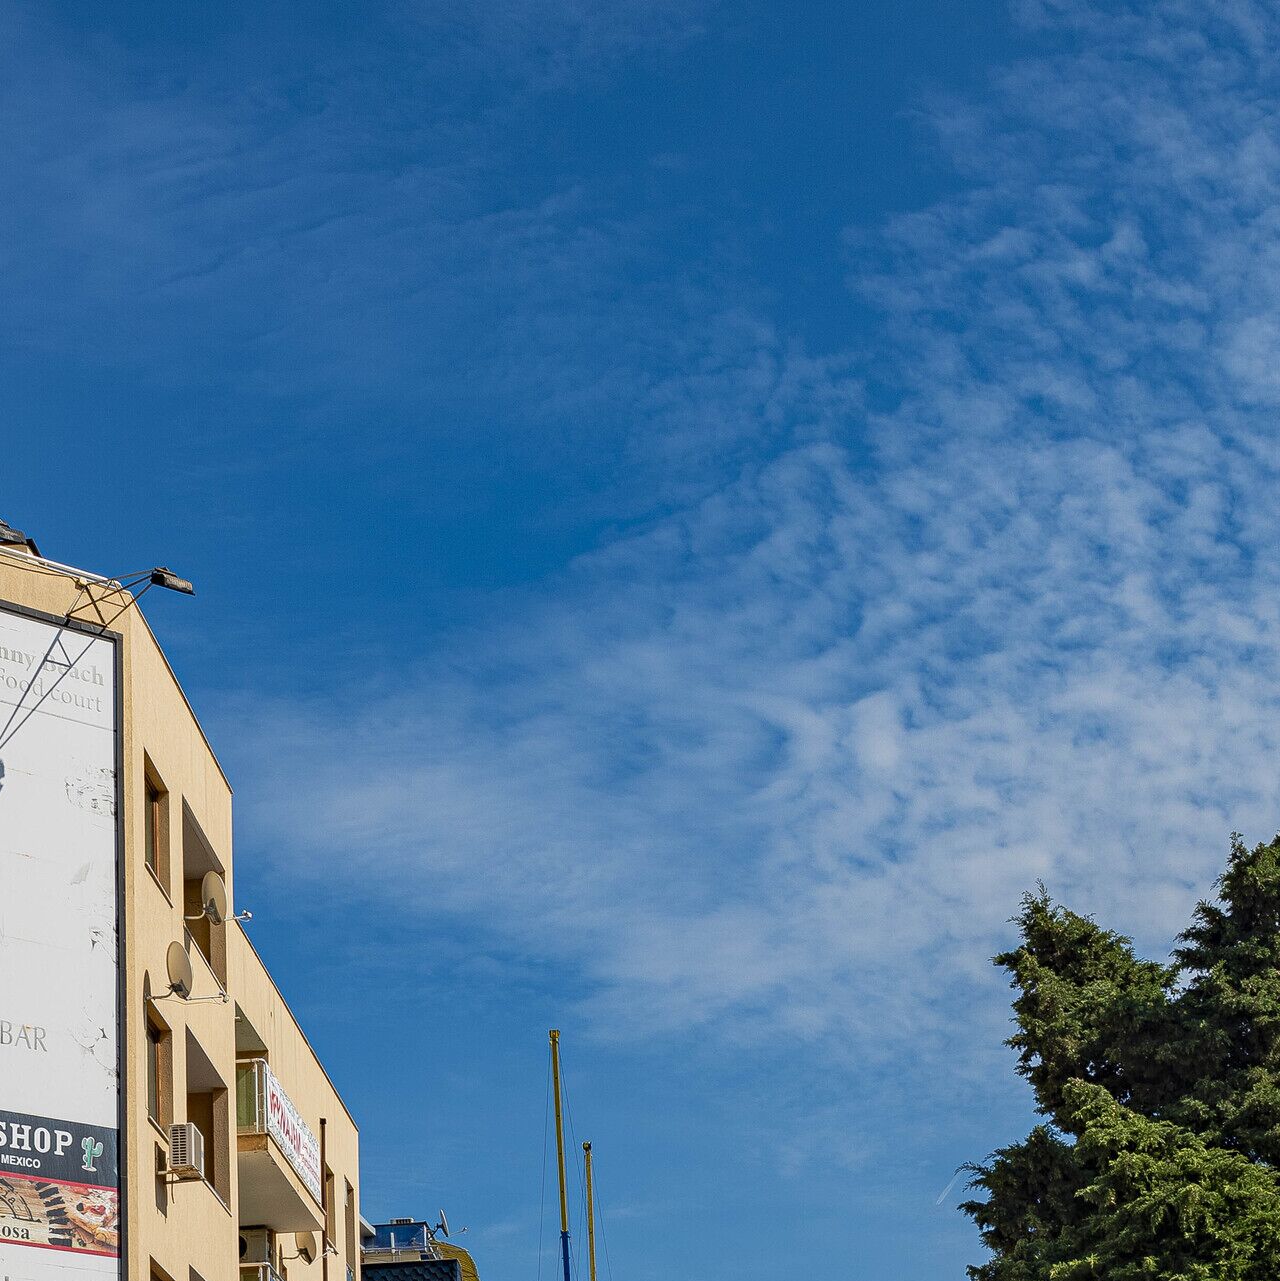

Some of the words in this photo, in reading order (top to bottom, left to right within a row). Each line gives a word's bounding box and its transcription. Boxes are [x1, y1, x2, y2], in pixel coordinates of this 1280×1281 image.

[42, 654, 105, 686] Beach
[50, 687, 103, 713] court
[0, 1019, 48, 1053] BAR
[1, 1152, 42, 1169] MEXICO
